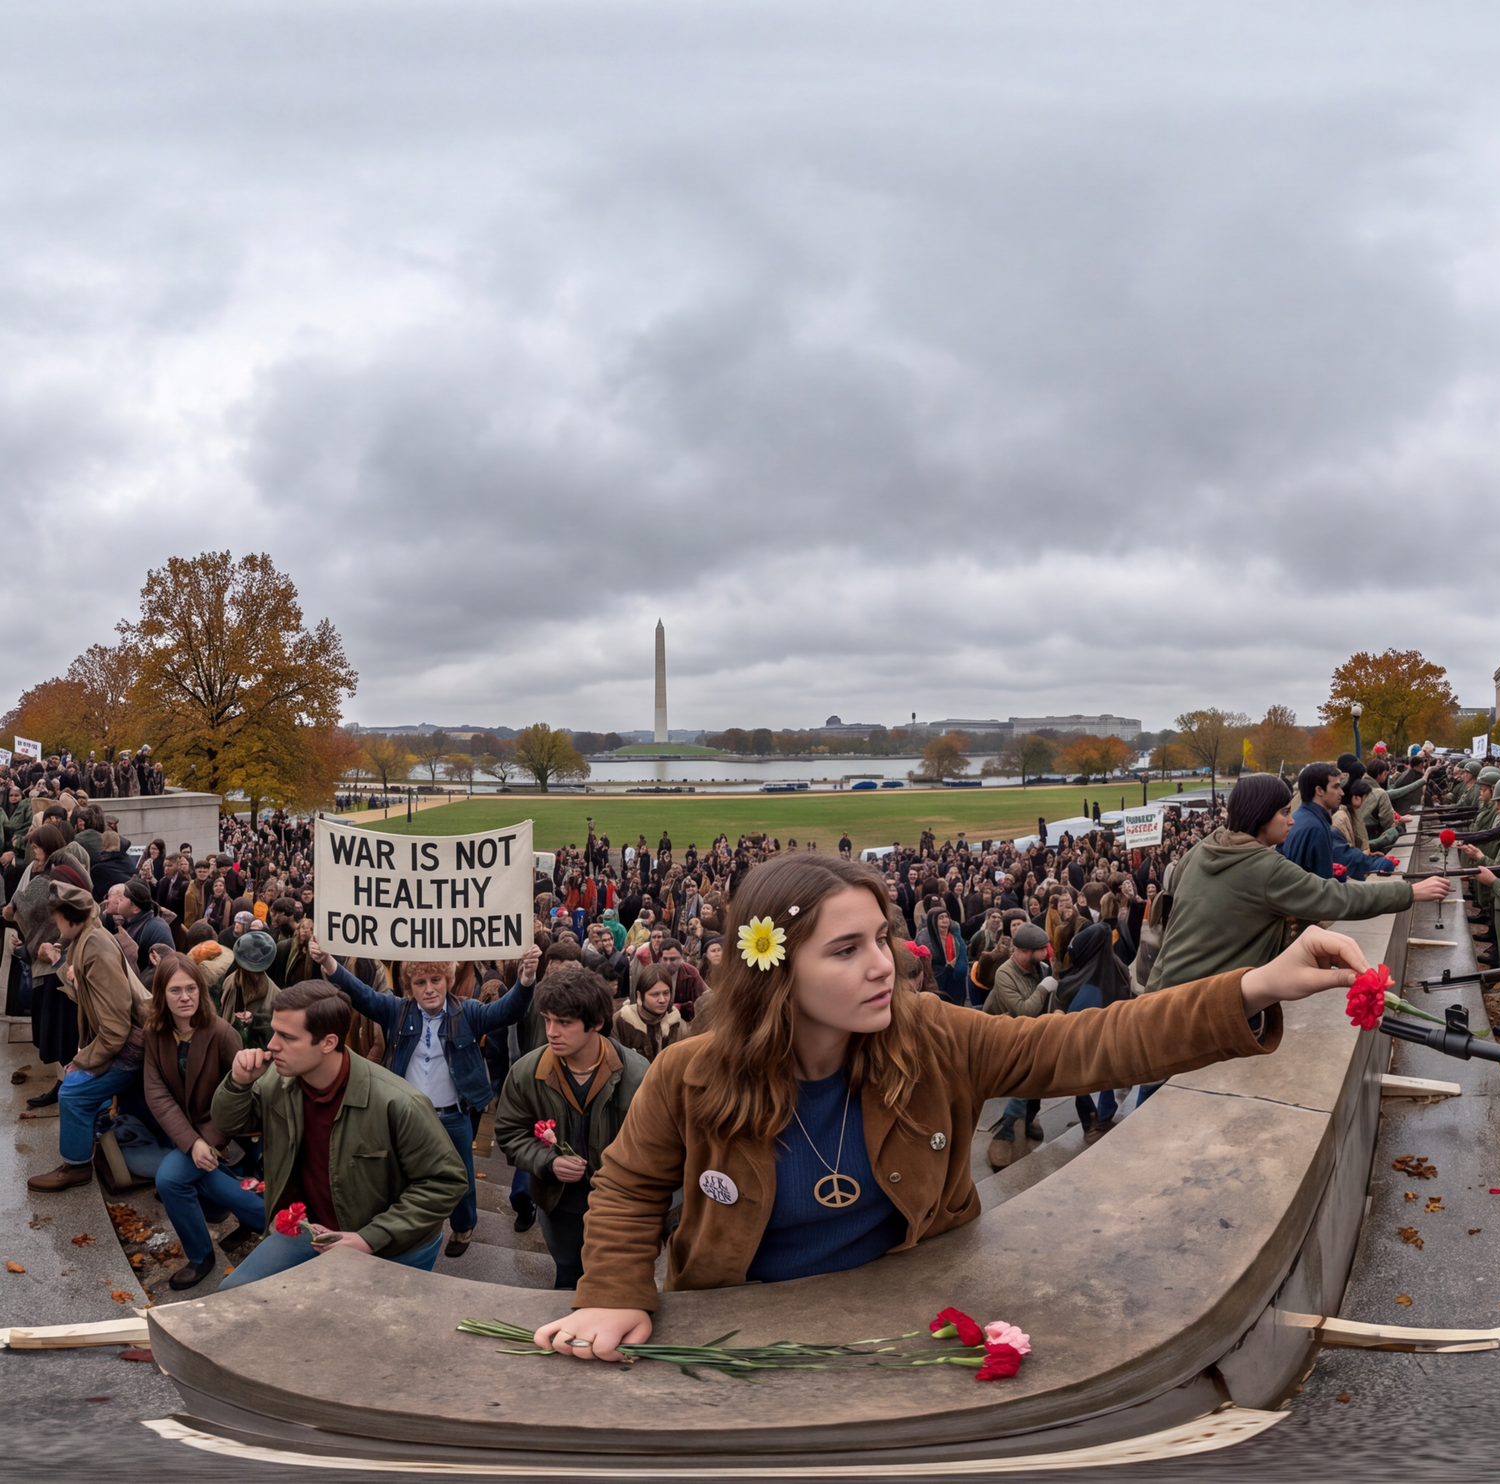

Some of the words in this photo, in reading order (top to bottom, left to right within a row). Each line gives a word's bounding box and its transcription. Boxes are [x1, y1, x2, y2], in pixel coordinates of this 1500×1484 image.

[329, 832, 396, 870] WAR
[410, 842, 440, 872] IS
[455, 833, 517, 871] NOT
[353, 874, 493, 909] HEALTHY
[327, 910, 379, 945] FOR
[389, 912, 523, 948] CHILDREN
